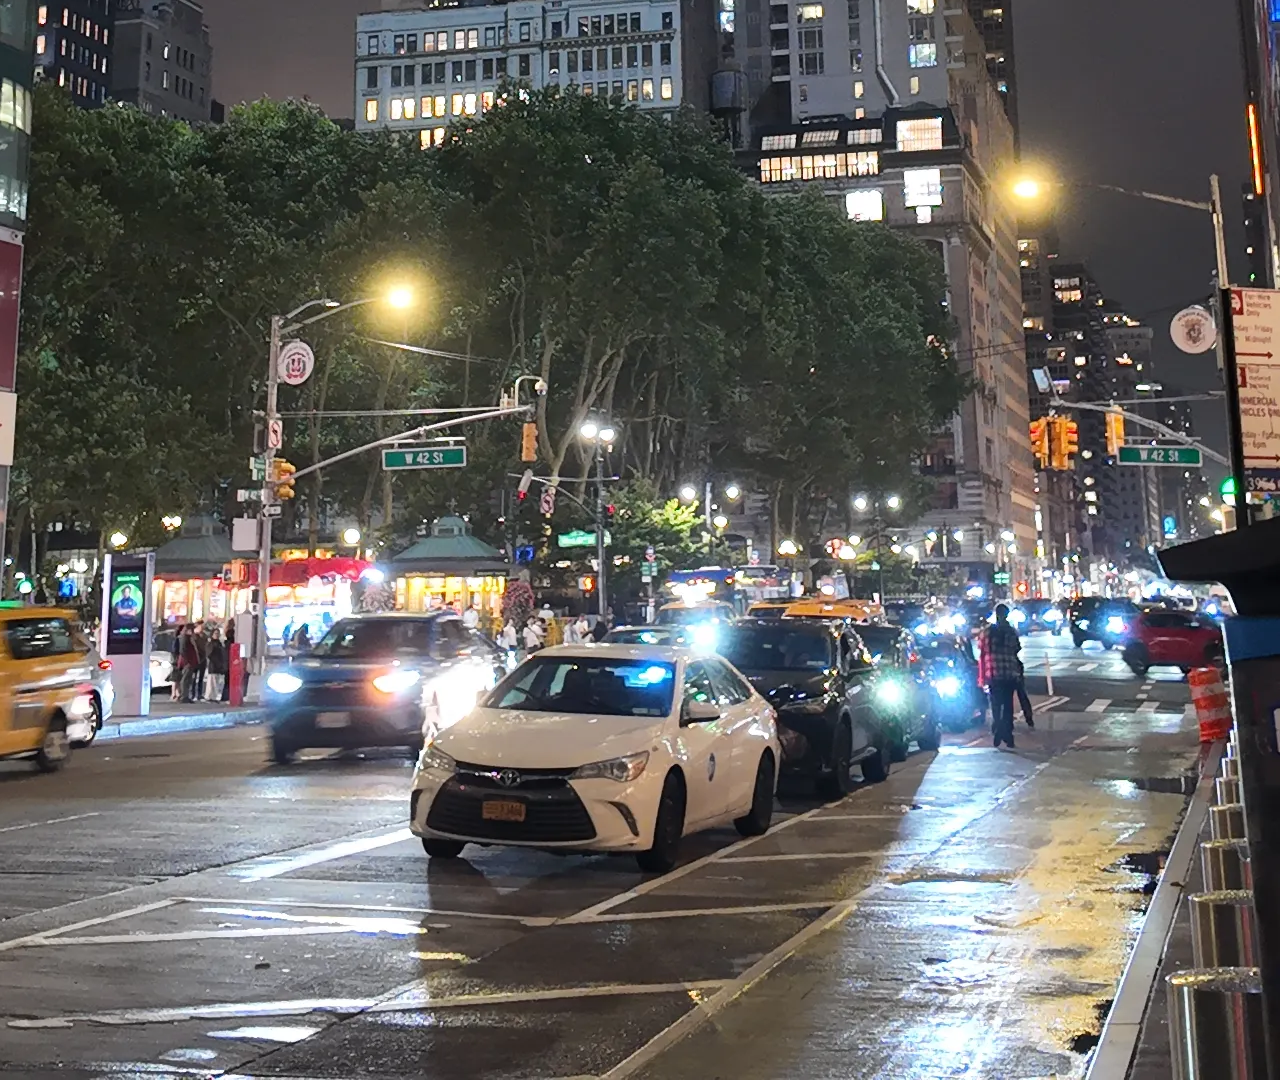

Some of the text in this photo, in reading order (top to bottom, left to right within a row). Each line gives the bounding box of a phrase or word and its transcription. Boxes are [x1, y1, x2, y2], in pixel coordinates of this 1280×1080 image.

[1240, 396, 1278, 407] MMERCIAL
[1241, 407, 1266, 418] HICLES
[405, 451, 444, 464] W 42 St
[1139, 449, 1179, 462] W 42 St
